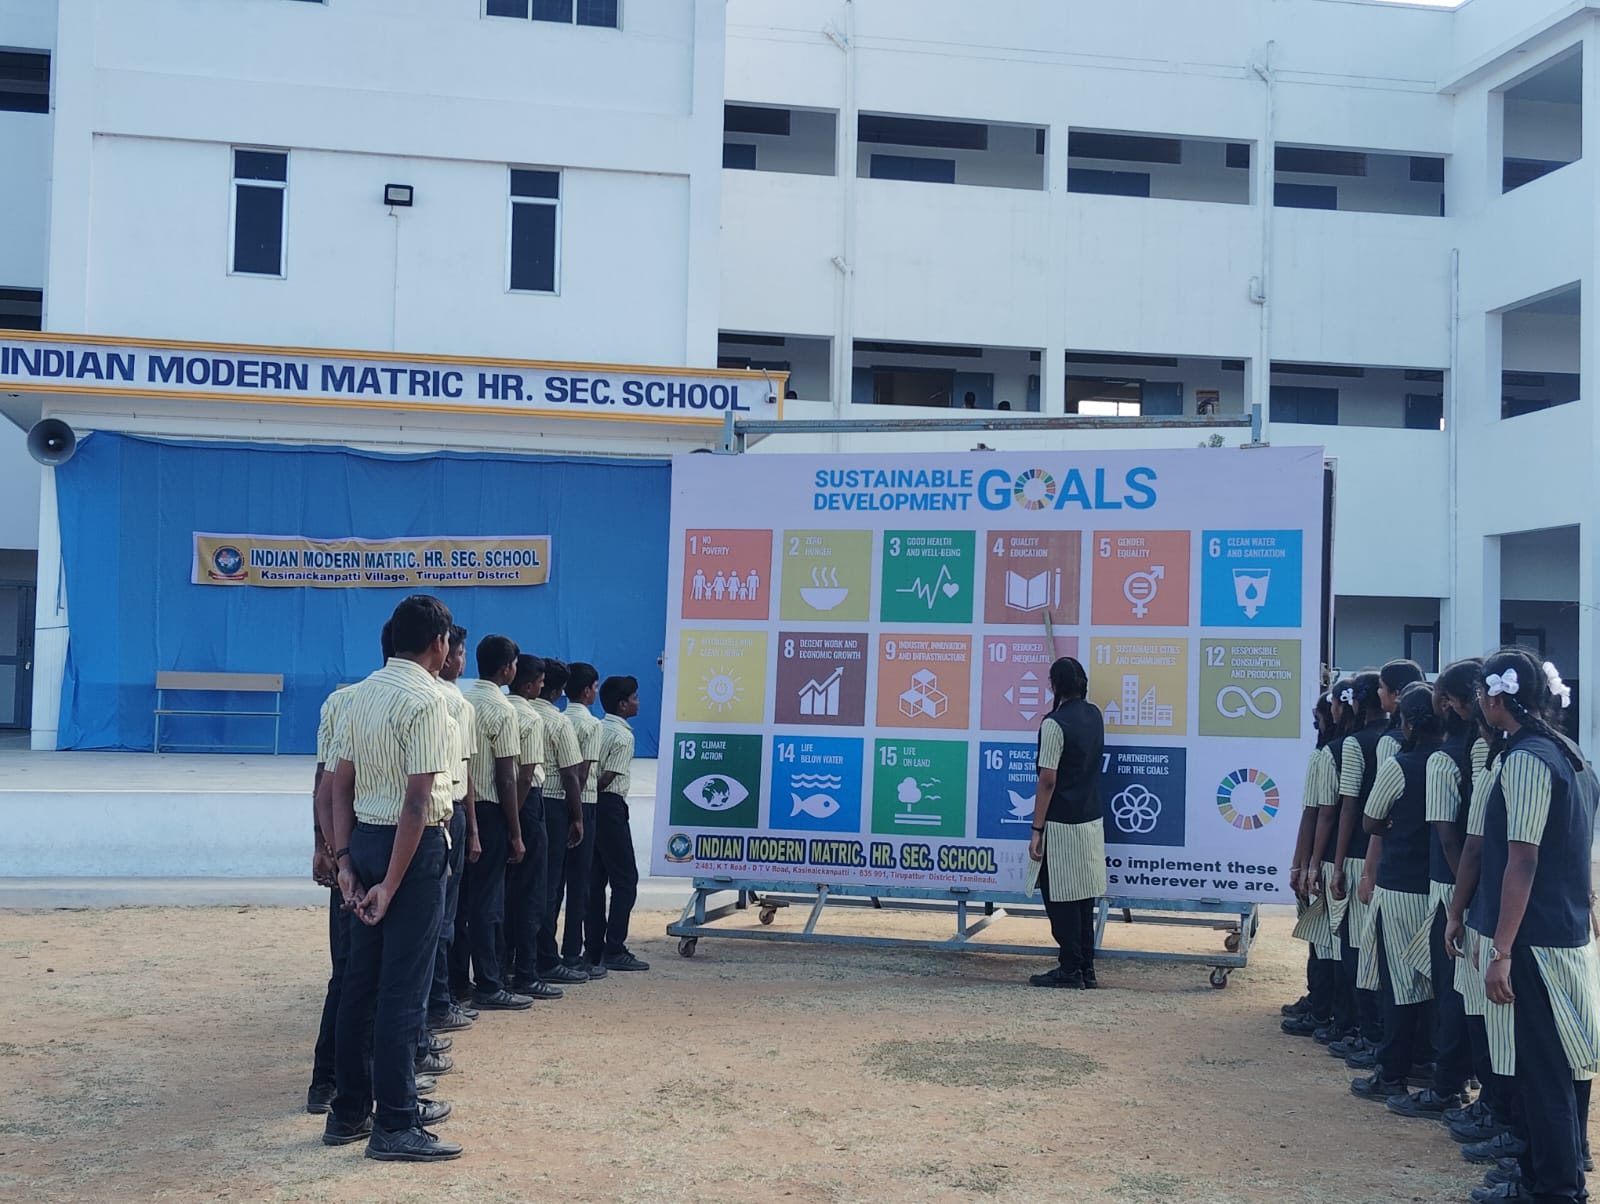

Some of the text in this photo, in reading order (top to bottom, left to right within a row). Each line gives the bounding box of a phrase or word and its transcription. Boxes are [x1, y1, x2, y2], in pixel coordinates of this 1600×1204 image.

[1, 347, 750, 411] INDIAN MODERN MATRIC HR. SEC. SCHOOL
[814, 469, 973, 488] SUSTAINABLE
[977, 466, 1158, 512] GOALS
[814, 492, 972, 511] DEVELOPMENT
[702, 536, 712, 544] NO
[805, 537, 822, 545] ZERO
[906, 537, 952, 546] GOOD HEALTH
[1010, 537, 1039, 546] QUALITY
[1118, 538, 1144, 546] GENDER
[1227, 538, 1276, 546] CLEAN WATER
[690, 536, 698, 555] 1
[789, 537, 800, 556] 2
[889, 537, 901, 556] 3
[993, 538, 1005, 557] 4
[1100, 538, 1111, 558] 5
[1209, 538, 1221, 558] 6
[702, 546, 730, 556] POVERTY
[906, 548, 961, 557] AND WELL-BEING
[1010, 548, 1048, 557] EDUCATION
[1118, 549, 1150, 558] EQUALITY
[1227, 549, 1285, 558] AND SANITATION
[251, 550, 298, 567] INDIAN
[303, 551, 360, 568] MODERN
[365, 552, 420, 568] MATRIC.
[424, 551, 446, 567] HR.
[451, 551, 480, 567] SEC.
[485, 550, 539, 567] SCHOOL
[262, 571, 520, 583] Kasinaickanpatti Village, Tirupattur District
[687, 637, 696, 656] 7
[784, 639, 794, 658] 8
[800, 640, 857, 648] DECENT WORK AND
[1012, 643, 1042, 652] REDUCED
[800, 650, 861, 660] ECONOMIC GROWTH
[885, 641, 896, 660] 9
[988, 643, 1007, 662] 10
[1095, 644, 1111, 664] 11
[1231, 646, 1278, 656] RESPONSIBLE
[899, 652, 911, 661] AND
[1115, 656, 1176, 665] AND COMMUNITIES
[1205, 646, 1225, 666] 12
[1231, 658, 1280, 667] CONSUMPTION
[1231, 670, 1291, 679] AND PRODUCTION
[678, 740, 696, 760] 13
[701, 741, 726, 750] CLIMATE
[801, 744, 813, 752] LIFE
[701, 752, 723, 760] ACTION
[778, 742, 795, 763] 14
[880, 746, 897, 766] 15
[903, 747, 916, 756] LIFE
[1009, 751, 1032, 760] PEACE,
[801, 755, 844, 764] BELOW WATER
[914, 759, 930, 767] LAND
[984, 749, 1003, 770] 16
[1102, 753, 1111, 773] 7
[1118, 754, 1169, 764] PARTNERSHIPS
[1008, 762, 1022, 770] AND
[1118, 766, 1169, 775] FOR THE GOALS
[1008, 774, 1040, 783] INSTITUT
[698, 836, 742, 860] INDIAN
[749, 838, 804, 862] MODERN
[811, 840, 865, 865] MATRIC.
[872, 844, 894, 867] HR.
[902, 845, 932, 868] SEC.
[939, 847, 996, 872] SCHOOL
[1105, 856, 1278, 875] to implement these
[1125, 874, 1207, 889] wherever
[1212, 880, 1238, 890] we
[1244, 881, 1279, 892] are.
